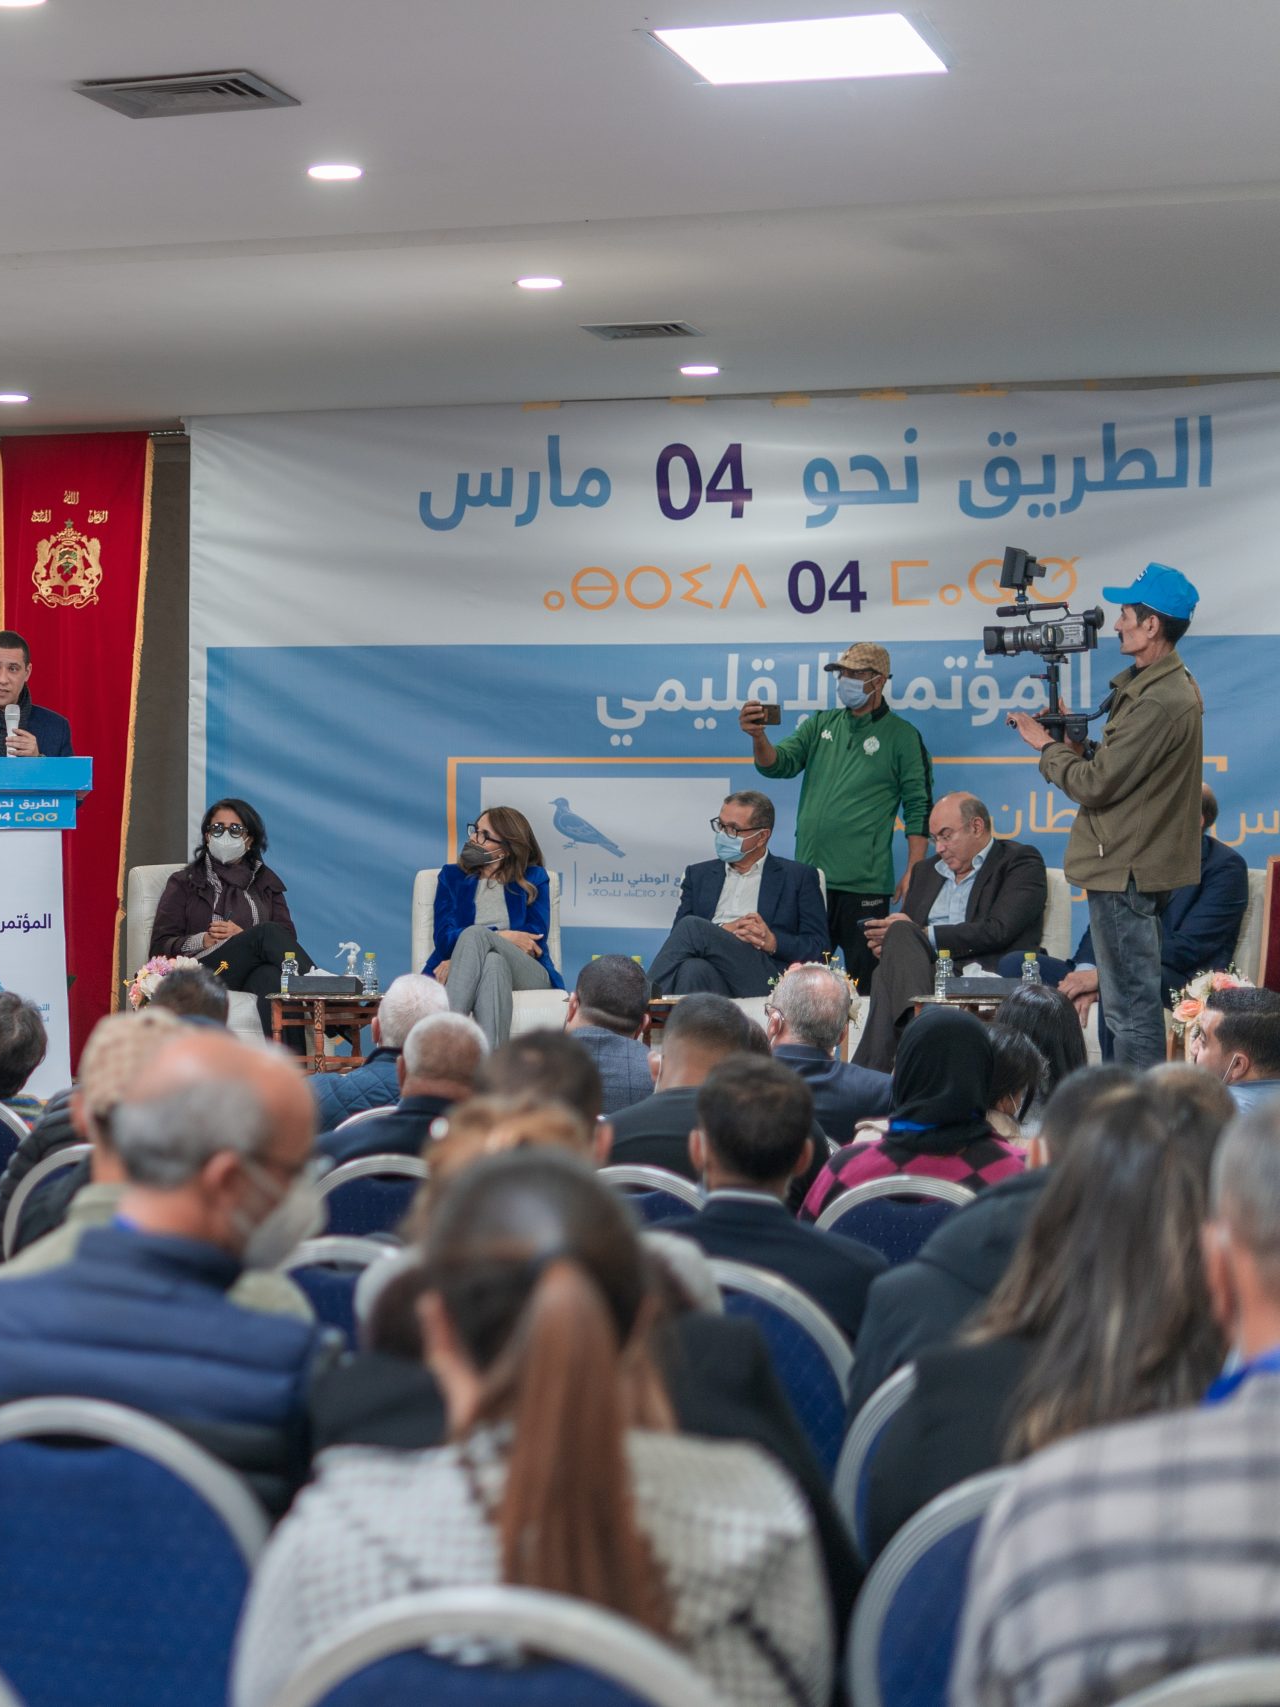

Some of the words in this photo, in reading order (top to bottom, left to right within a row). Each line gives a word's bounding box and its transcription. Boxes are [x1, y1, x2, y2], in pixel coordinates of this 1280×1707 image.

[418, 434, 612, 531] مارس
[655, 443, 753, 521] 04
[802, 427, 919, 529] نحو
[958, 415, 1213, 520] الطريق
[787, 560, 867, 614] 04
[19, 799, 59, 809] الطريق
[627, 873, 670, 888] الوطني
[0, 913, 52, 933] المؤتمر
